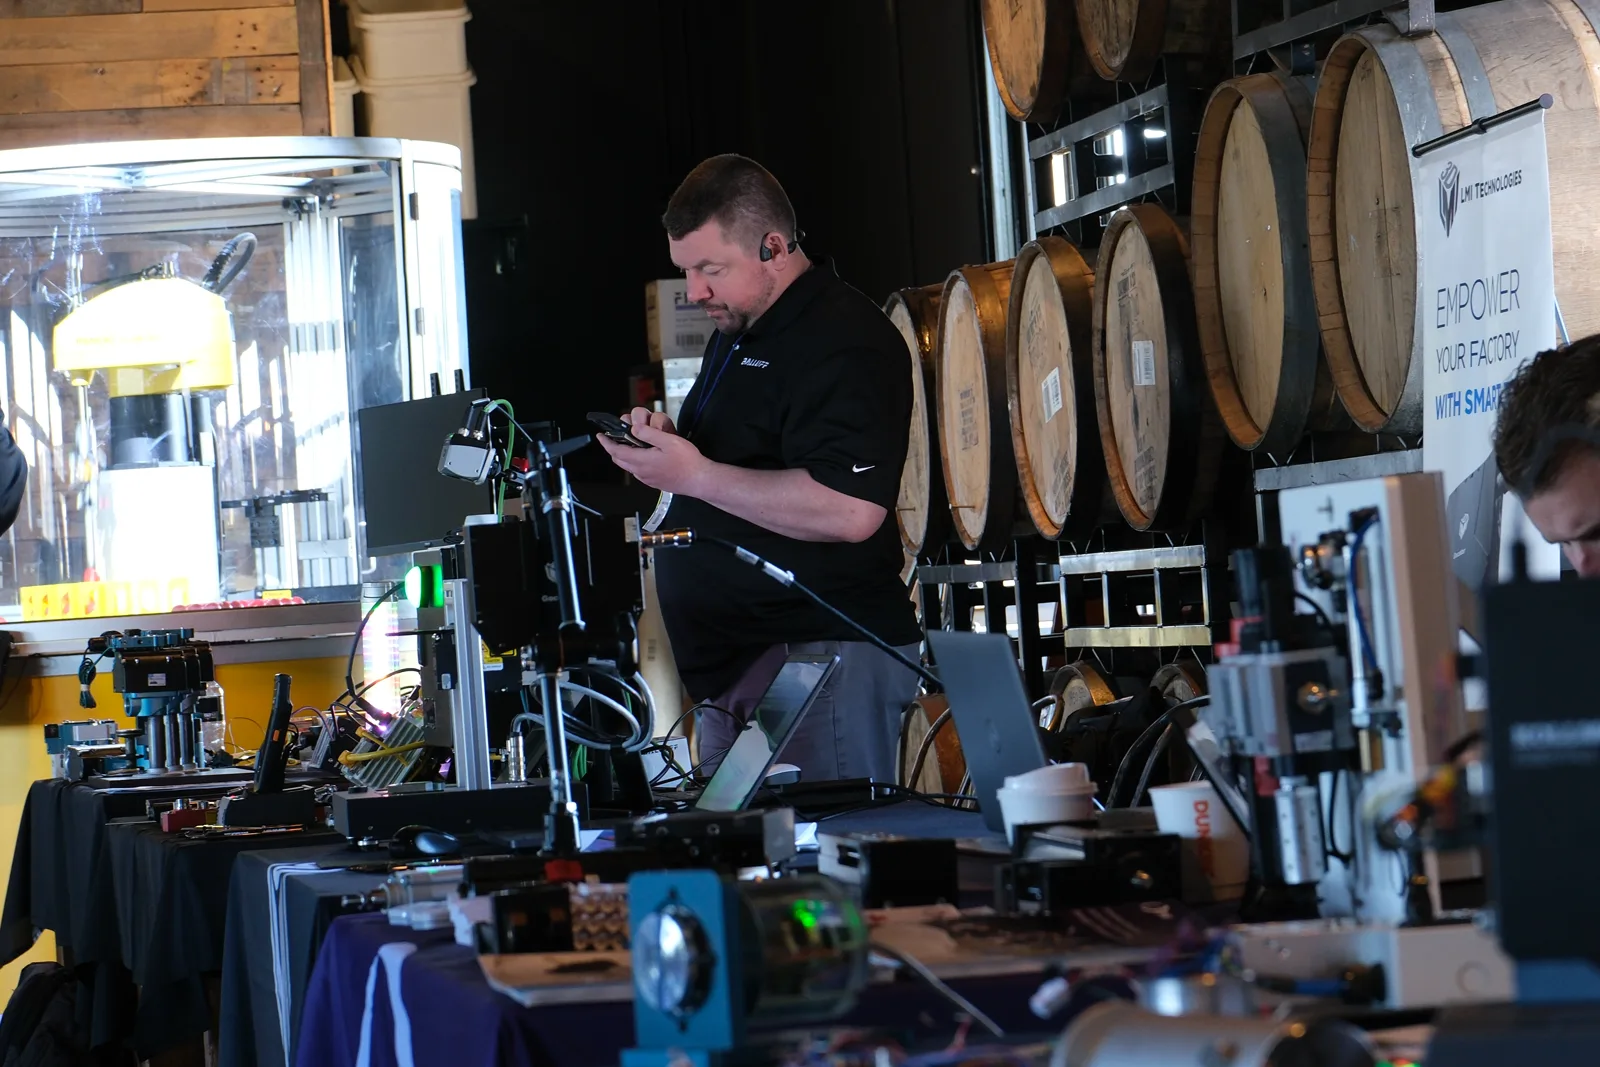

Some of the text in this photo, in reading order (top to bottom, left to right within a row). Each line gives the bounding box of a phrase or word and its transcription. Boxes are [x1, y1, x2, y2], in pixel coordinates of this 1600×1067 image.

[1460, 169, 1522, 203] LMI TECHNOLOGIES
[1436, 269, 1520, 329] EMPOWER
[740, 357, 770, 369] BALLUFF
[1436, 330, 1520, 374] YOUR FACTORY
[1435, 383, 1502, 420] WITH SMART
